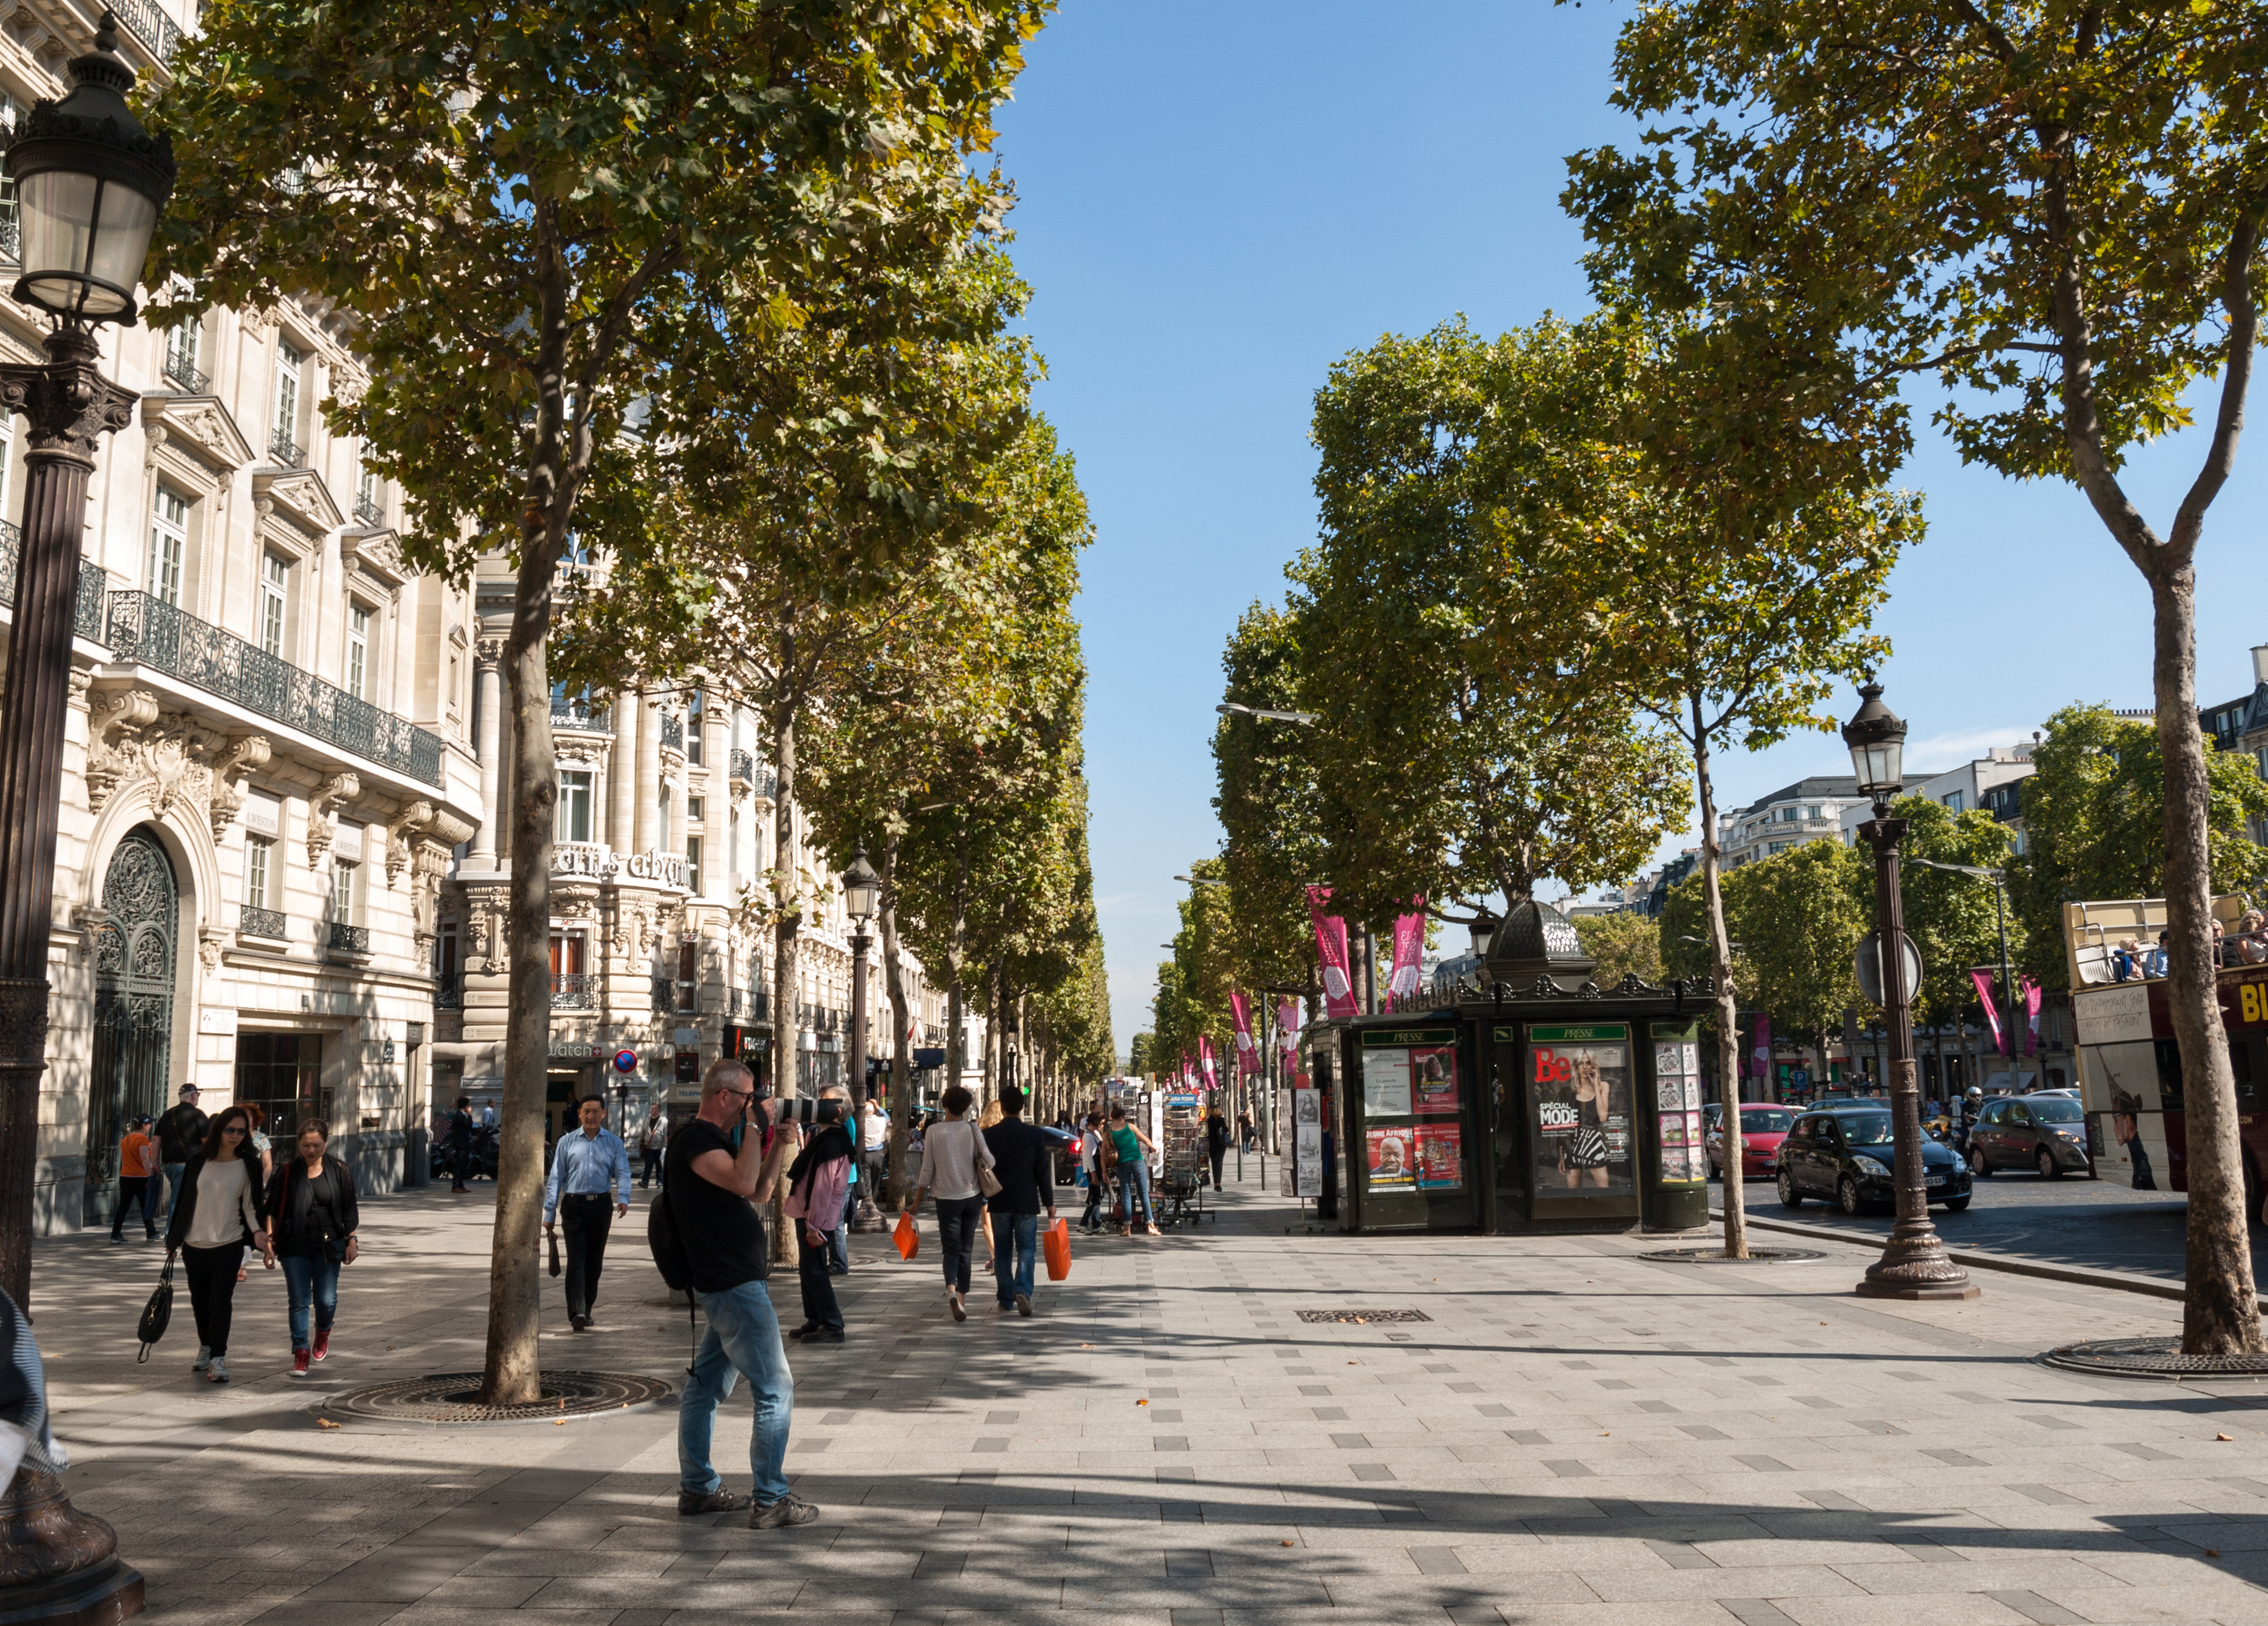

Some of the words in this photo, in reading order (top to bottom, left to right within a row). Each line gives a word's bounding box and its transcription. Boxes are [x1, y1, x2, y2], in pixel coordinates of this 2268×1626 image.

[1393, 1032, 1424, 1043] PRESSE
[1564, 1029, 1595, 1039] PRESSE
[548, 1044, 592, 1056] watch
[1533, 1047, 1571, 1082] Be
[1539, 1101, 1571, 1109] SPÉCIAL
[1540, 1109, 1579, 1124] MODE
[1366, 1129, 1385, 1138] JEUNE
[1386, 1128, 1413, 1137] AFRIQUE
